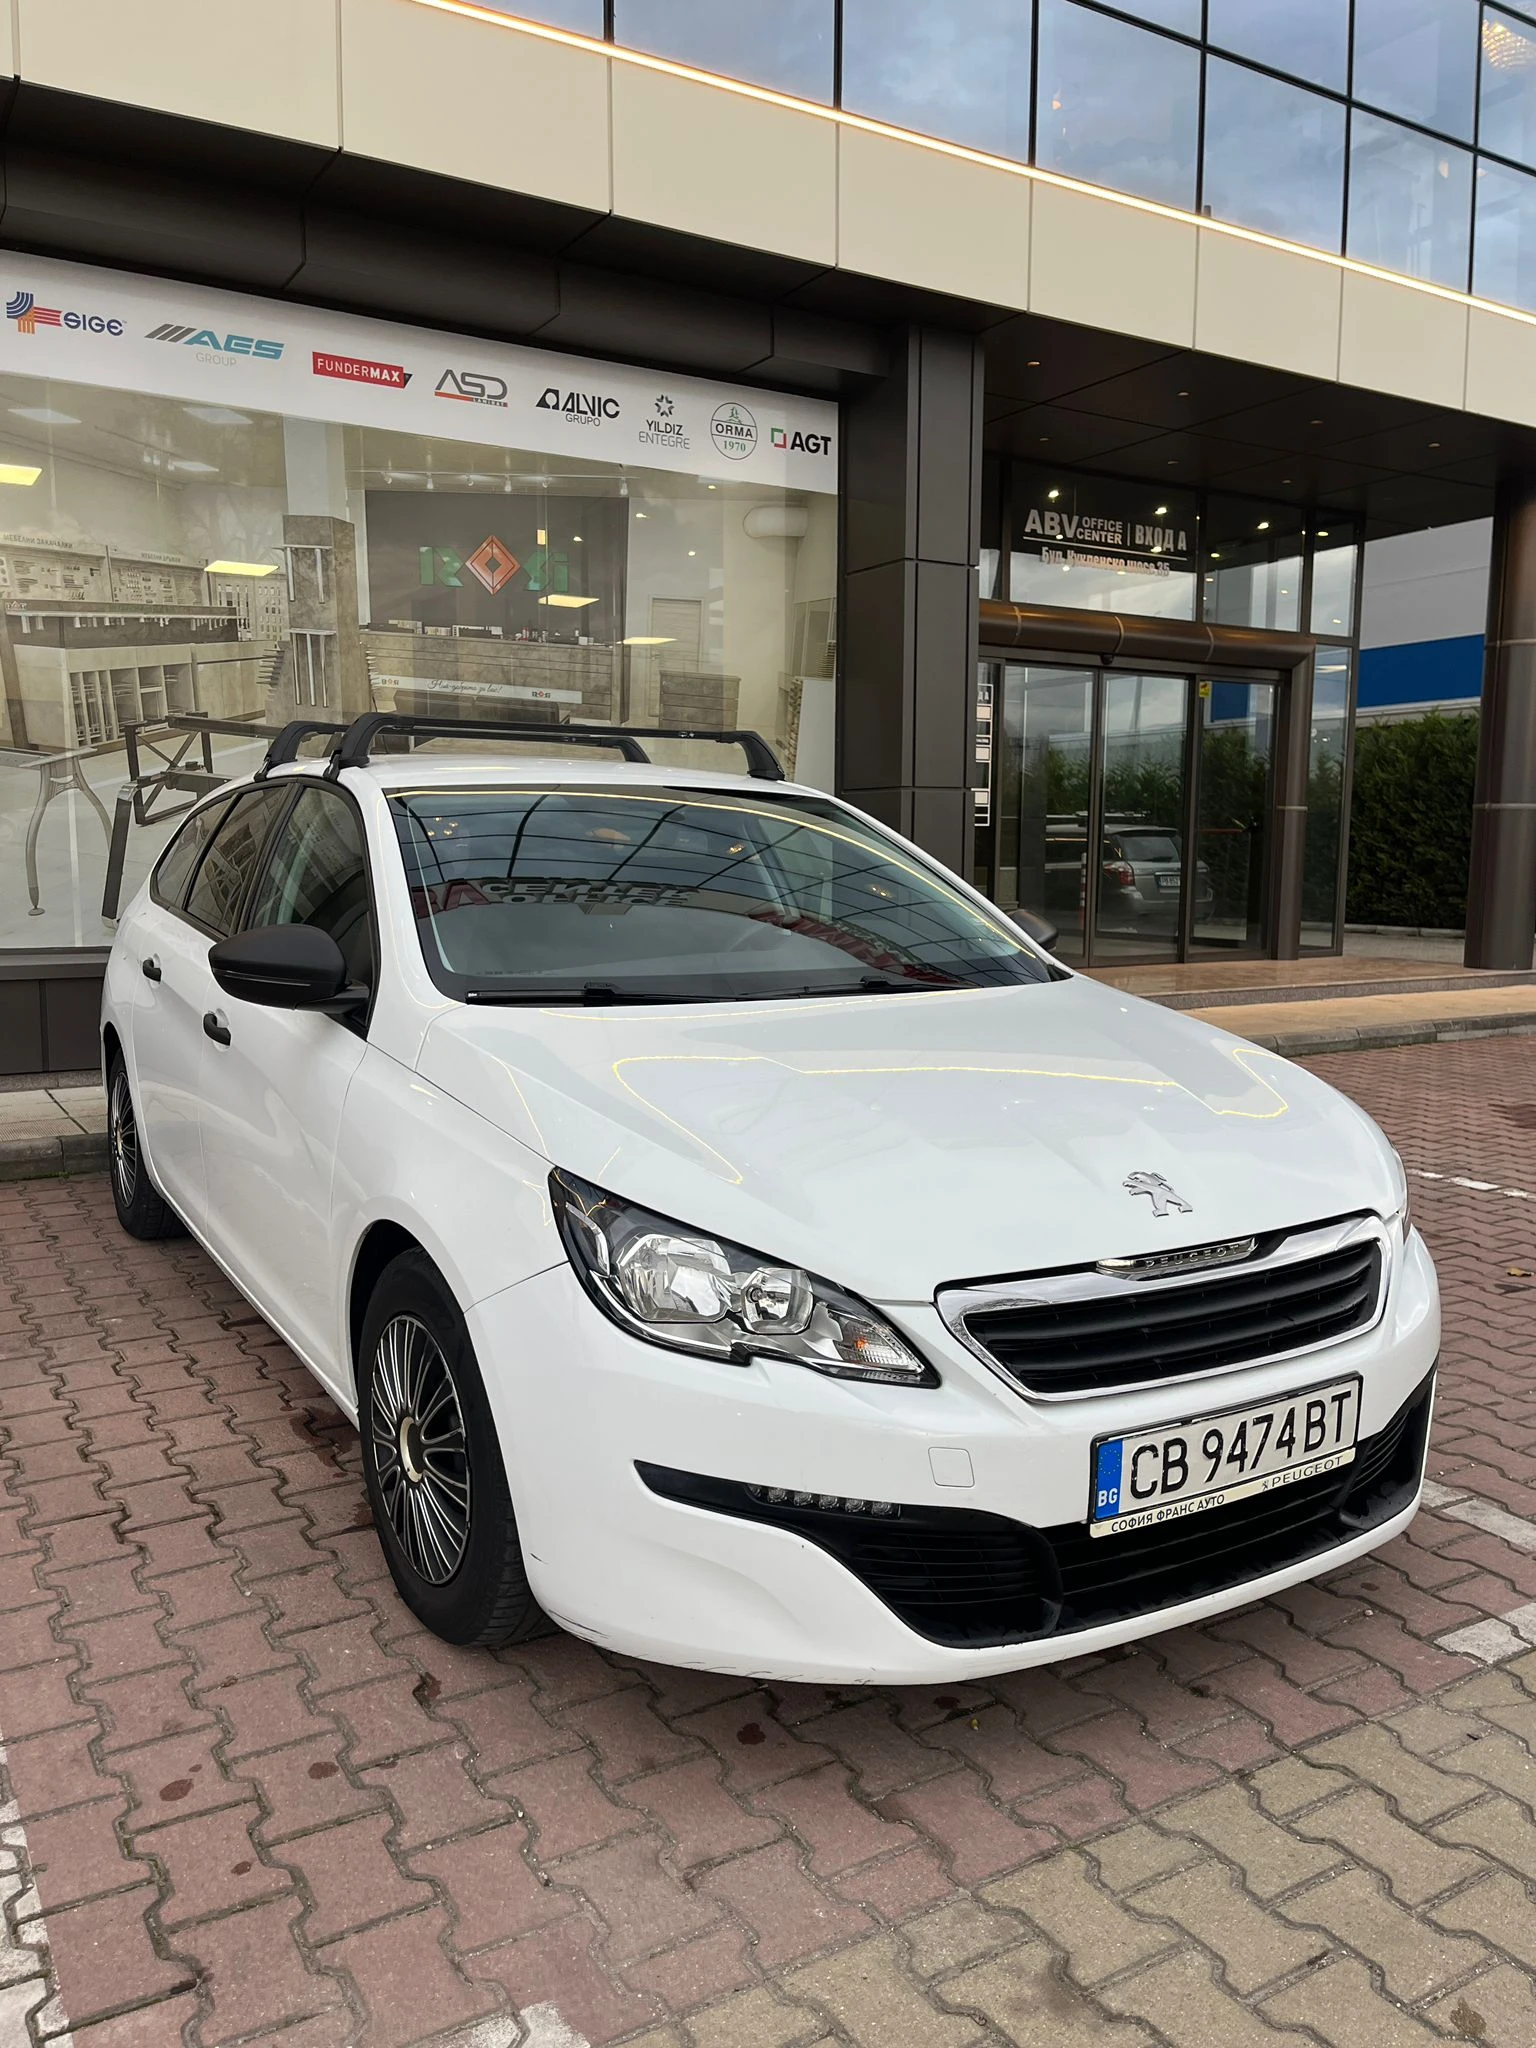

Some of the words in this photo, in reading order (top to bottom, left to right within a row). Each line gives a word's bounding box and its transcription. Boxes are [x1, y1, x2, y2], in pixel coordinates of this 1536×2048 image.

[64, 311, 123, 336] SIGE
[184, 329, 285, 361] AES
[195, 352, 238, 367] GROUP
[317, 358, 400, 383] FUNDERMAX
[435, 369, 508, 400] ASD
[561, 391, 620, 419] ALVIC
[565, 413, 601, 427] GRUPO
[646, 419, 683, 437] YILDIZ
[715, 423, 753, 439] ORMA
[638, 431, 691, 450] ENTEGRE
[723, 440, 746, 452] 1970
[790, 431, 832, 456] AGT
[1024, 509, 1079, 539] ABV
[1082, 516, 1123, 533] OFFICE
[1076, 529, 1123, 545] CENTER
[1135, 524, 1175, 552] ВХОД
[1178, 531, 1187, 551] А
[1145, 1242, 1242, 1270] PEUGEOT
[1130, 1436, 1189, 1500] CB
[1202, 1406, 1297, 1484] 9474
[1271, 1455, 1344, 1487] PEUGEOT
[1097, 1488, 1119, 1508] BG
[1111, 1512, 1153, 1533] СОФИЯ
[1156, 1500, 1195, 1522] ФРАНС
[1197, 1494, 1225, 1512] АУТО
